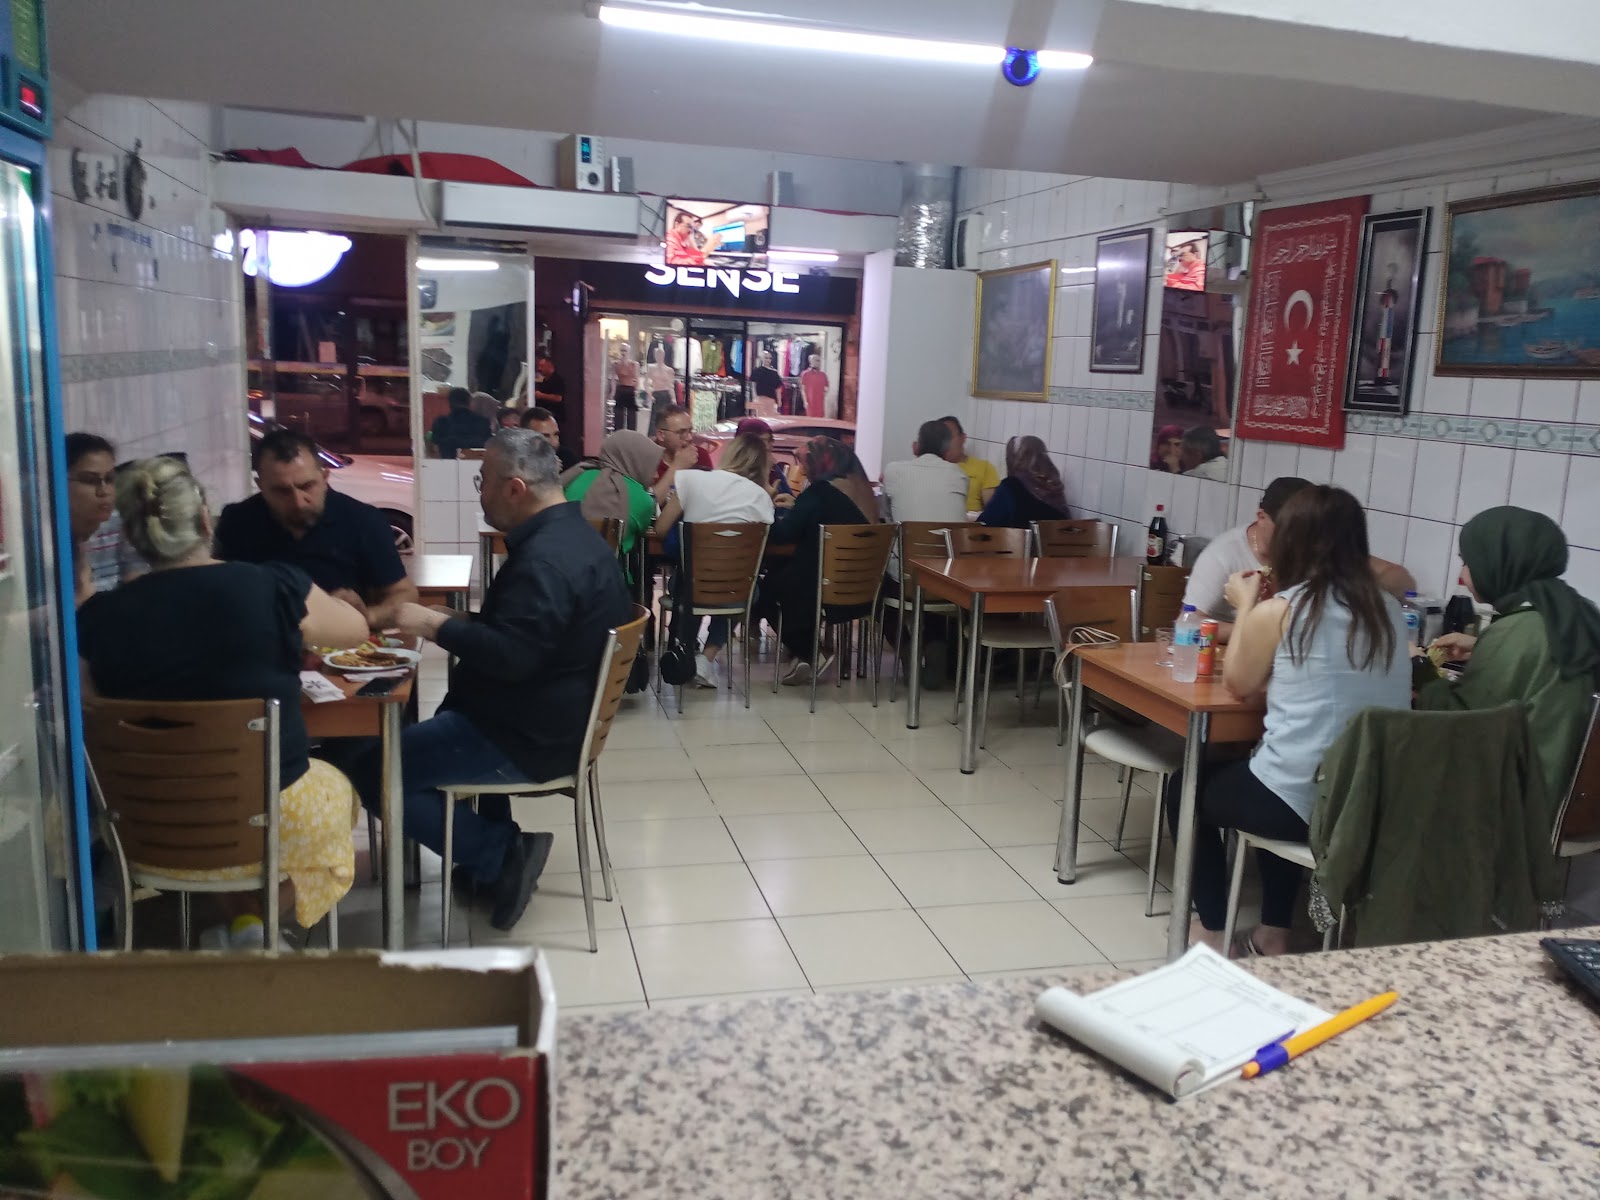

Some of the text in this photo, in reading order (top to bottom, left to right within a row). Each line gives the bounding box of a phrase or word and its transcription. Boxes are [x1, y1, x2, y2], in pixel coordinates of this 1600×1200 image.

[645, 263, 800, 299] SENSE
[388, 1077, 521, 1132] EKO
[407, 1136, 491, 1171] BOY
